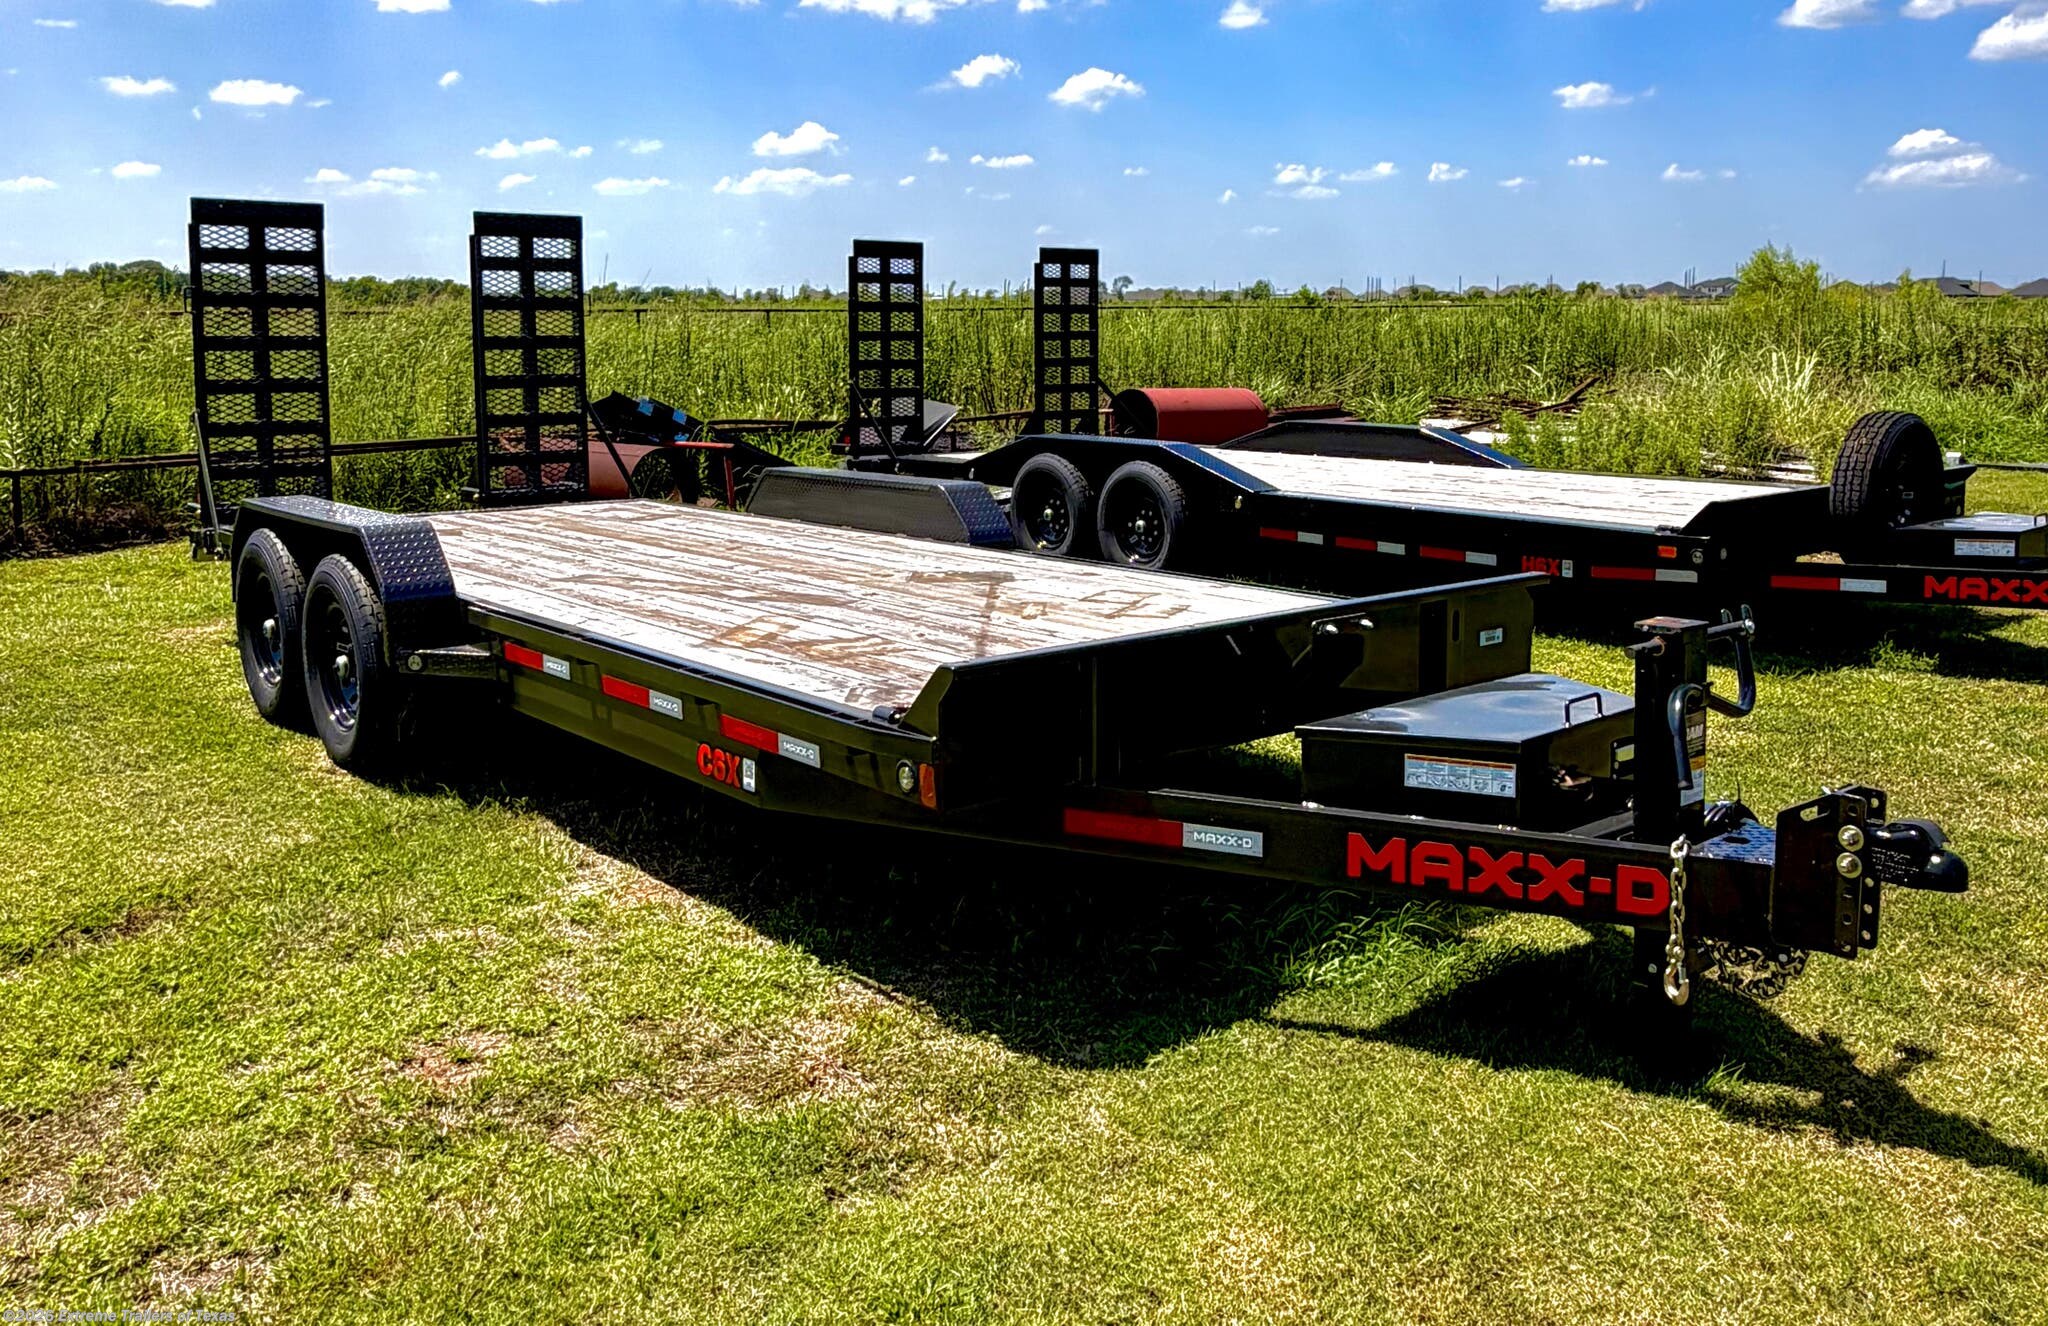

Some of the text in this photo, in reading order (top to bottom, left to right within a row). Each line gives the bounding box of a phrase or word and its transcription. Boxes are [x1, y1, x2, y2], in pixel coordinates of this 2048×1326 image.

[696, 743, 741, 789] C6X
[1193, 831, 1252, 849] MAXX-D
[1347, 831, 1671, 915] MAXX-D
